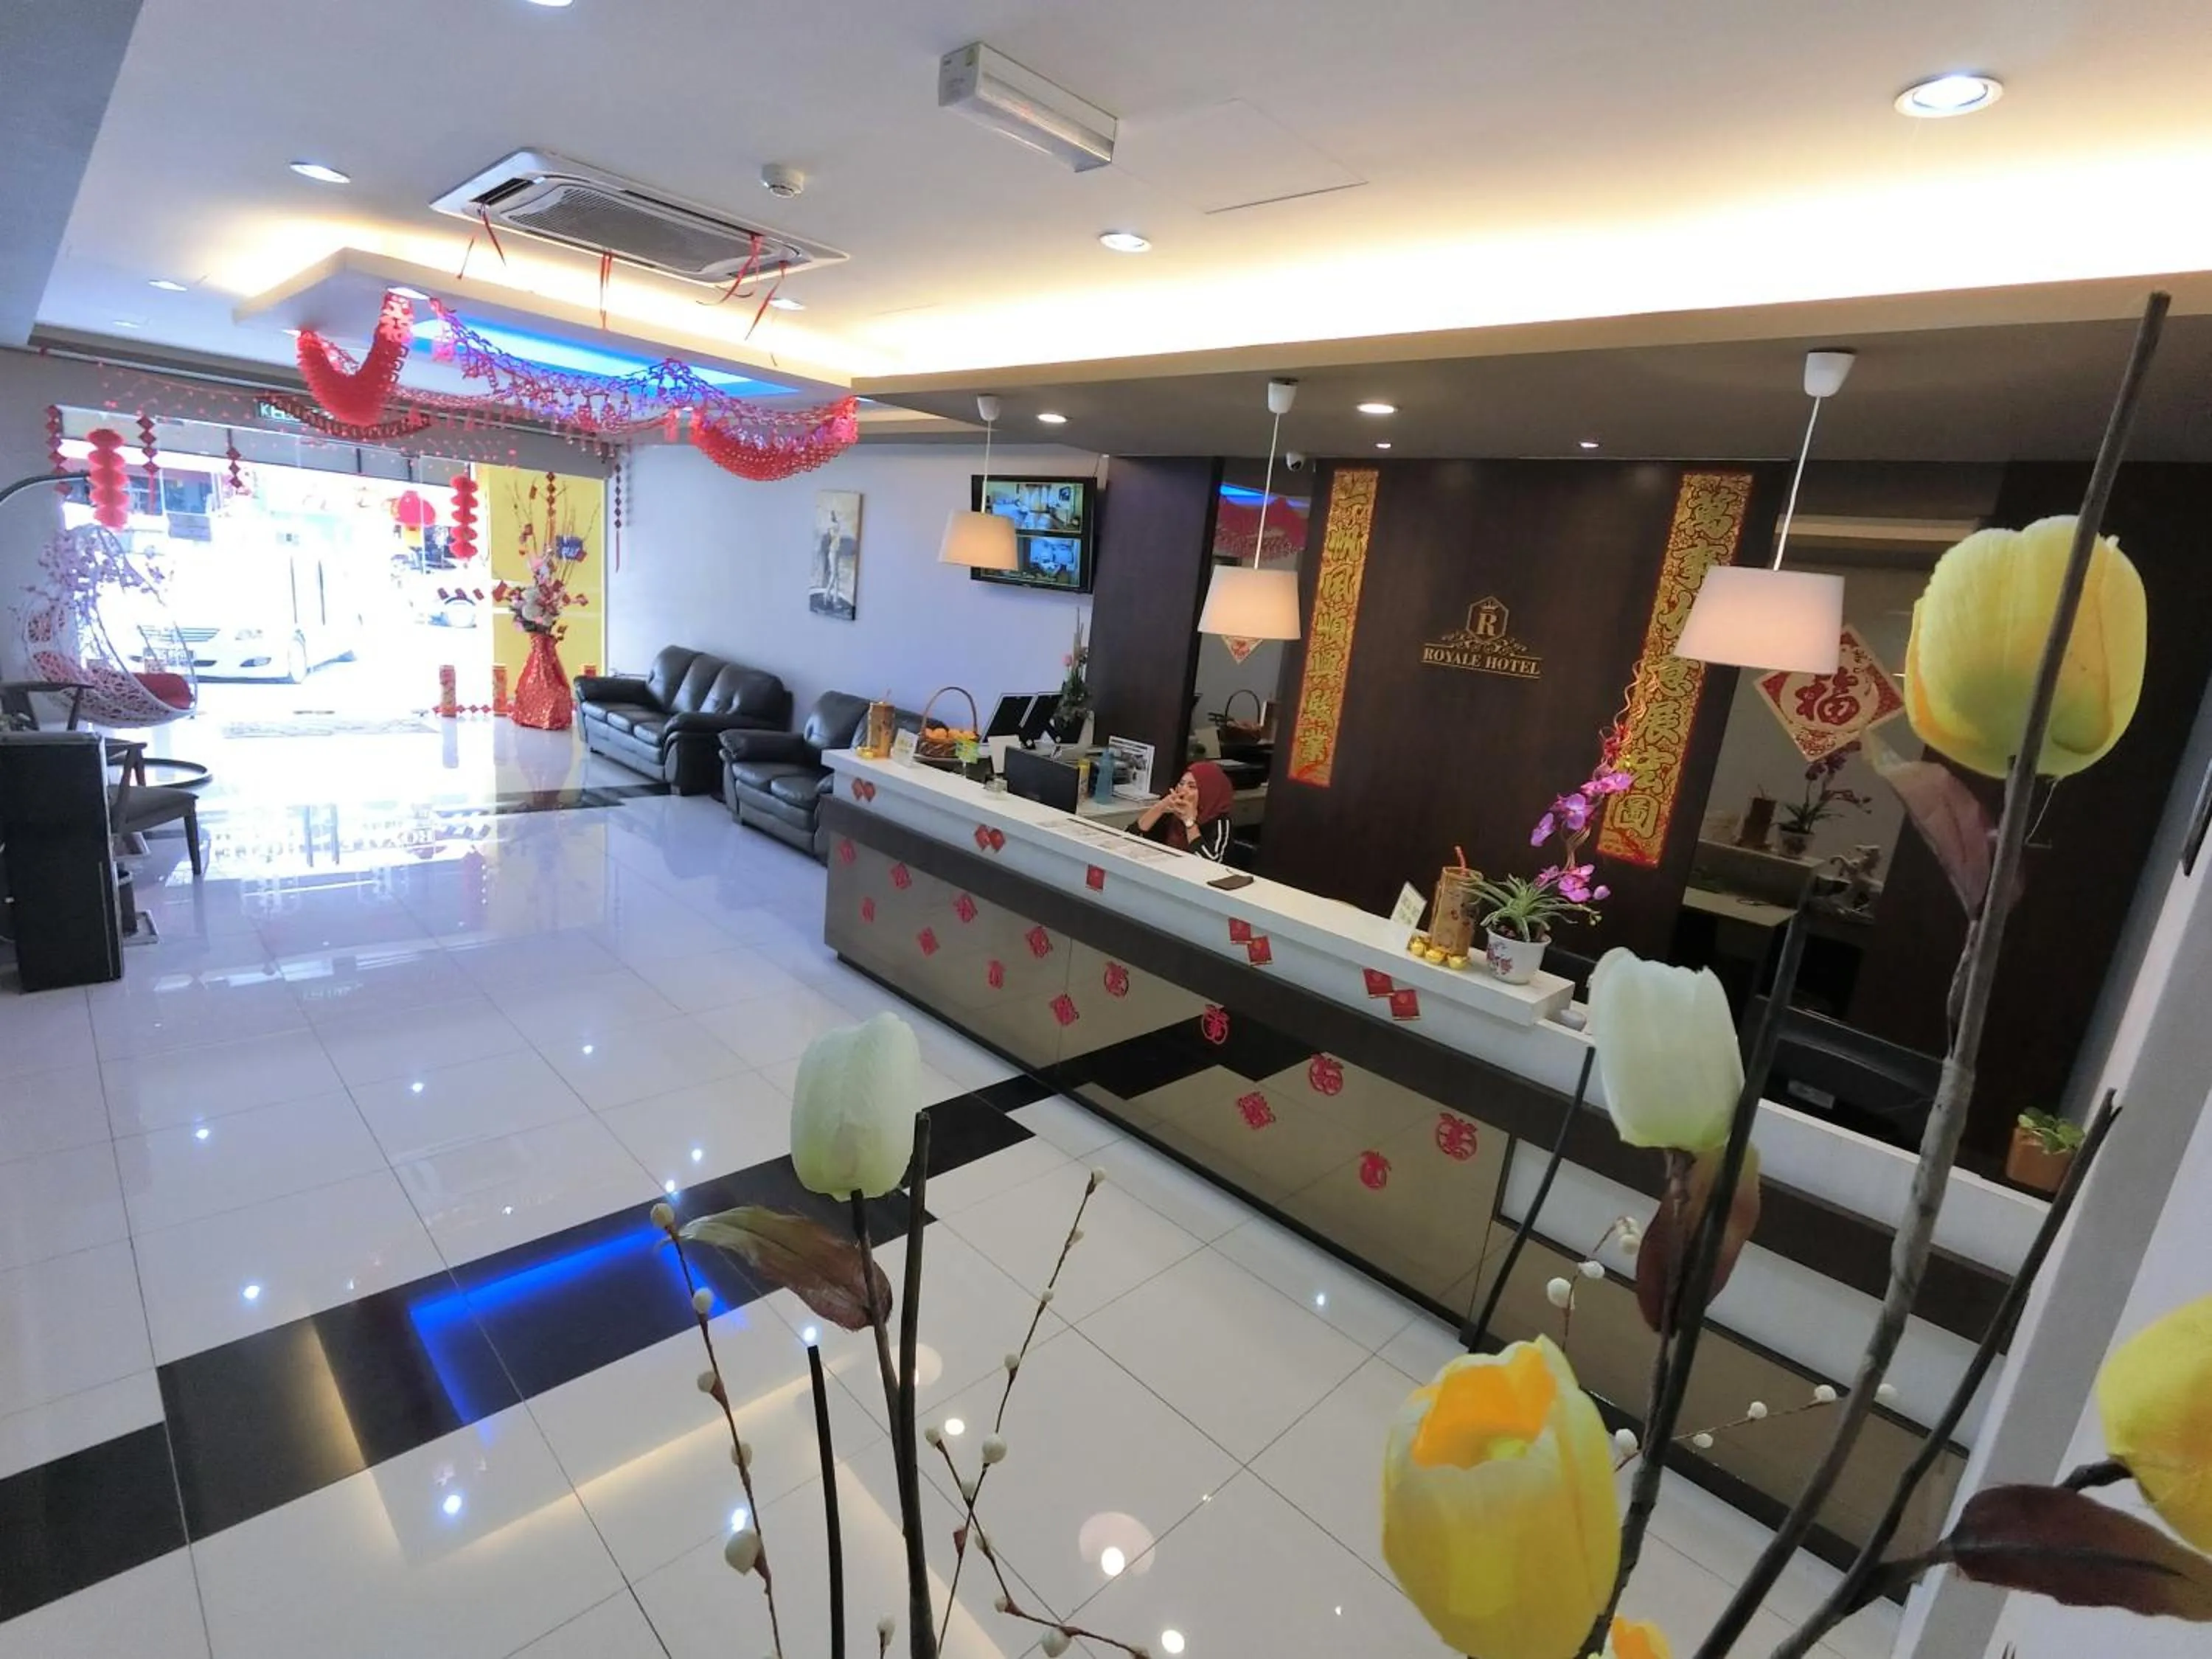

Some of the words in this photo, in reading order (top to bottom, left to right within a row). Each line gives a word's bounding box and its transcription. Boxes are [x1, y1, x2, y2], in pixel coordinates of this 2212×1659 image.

[1475, 613, 1497, 636] R
[1423, 647, 1481, 667] ROYALE
[1485, 657, 1540, 675] HOTEL
